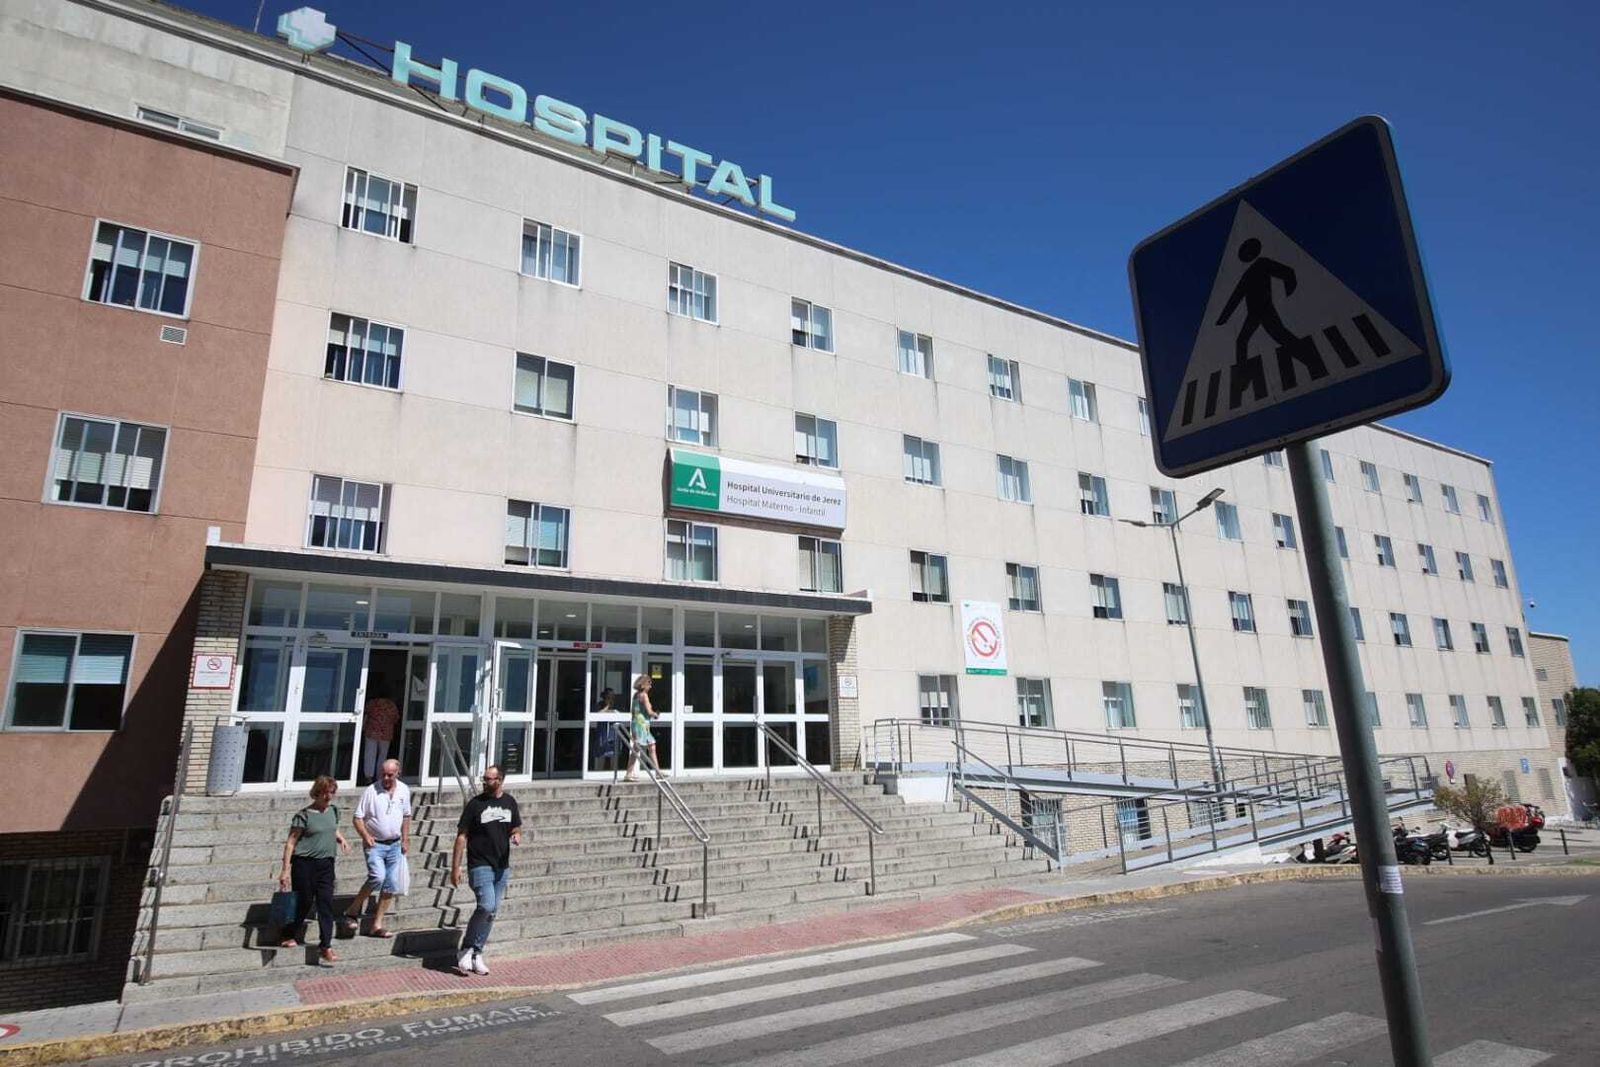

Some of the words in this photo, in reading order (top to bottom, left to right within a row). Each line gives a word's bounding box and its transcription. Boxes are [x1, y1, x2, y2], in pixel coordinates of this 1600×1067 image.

[392, 40, 796, 222] HOSPITAL
[727, 481, 760, 493] Hospital
[761, 486, 811, 500] Universitario
[811, 494, 821, 502] de
[822, 496, 841, 506] Jerez
[727, 495, 760, 507] Hospital
[762, 500, 793, 512] Materno
[799, 506, 826, 516] Infantil
[401, 1005, 538, 1033] FUMAR
